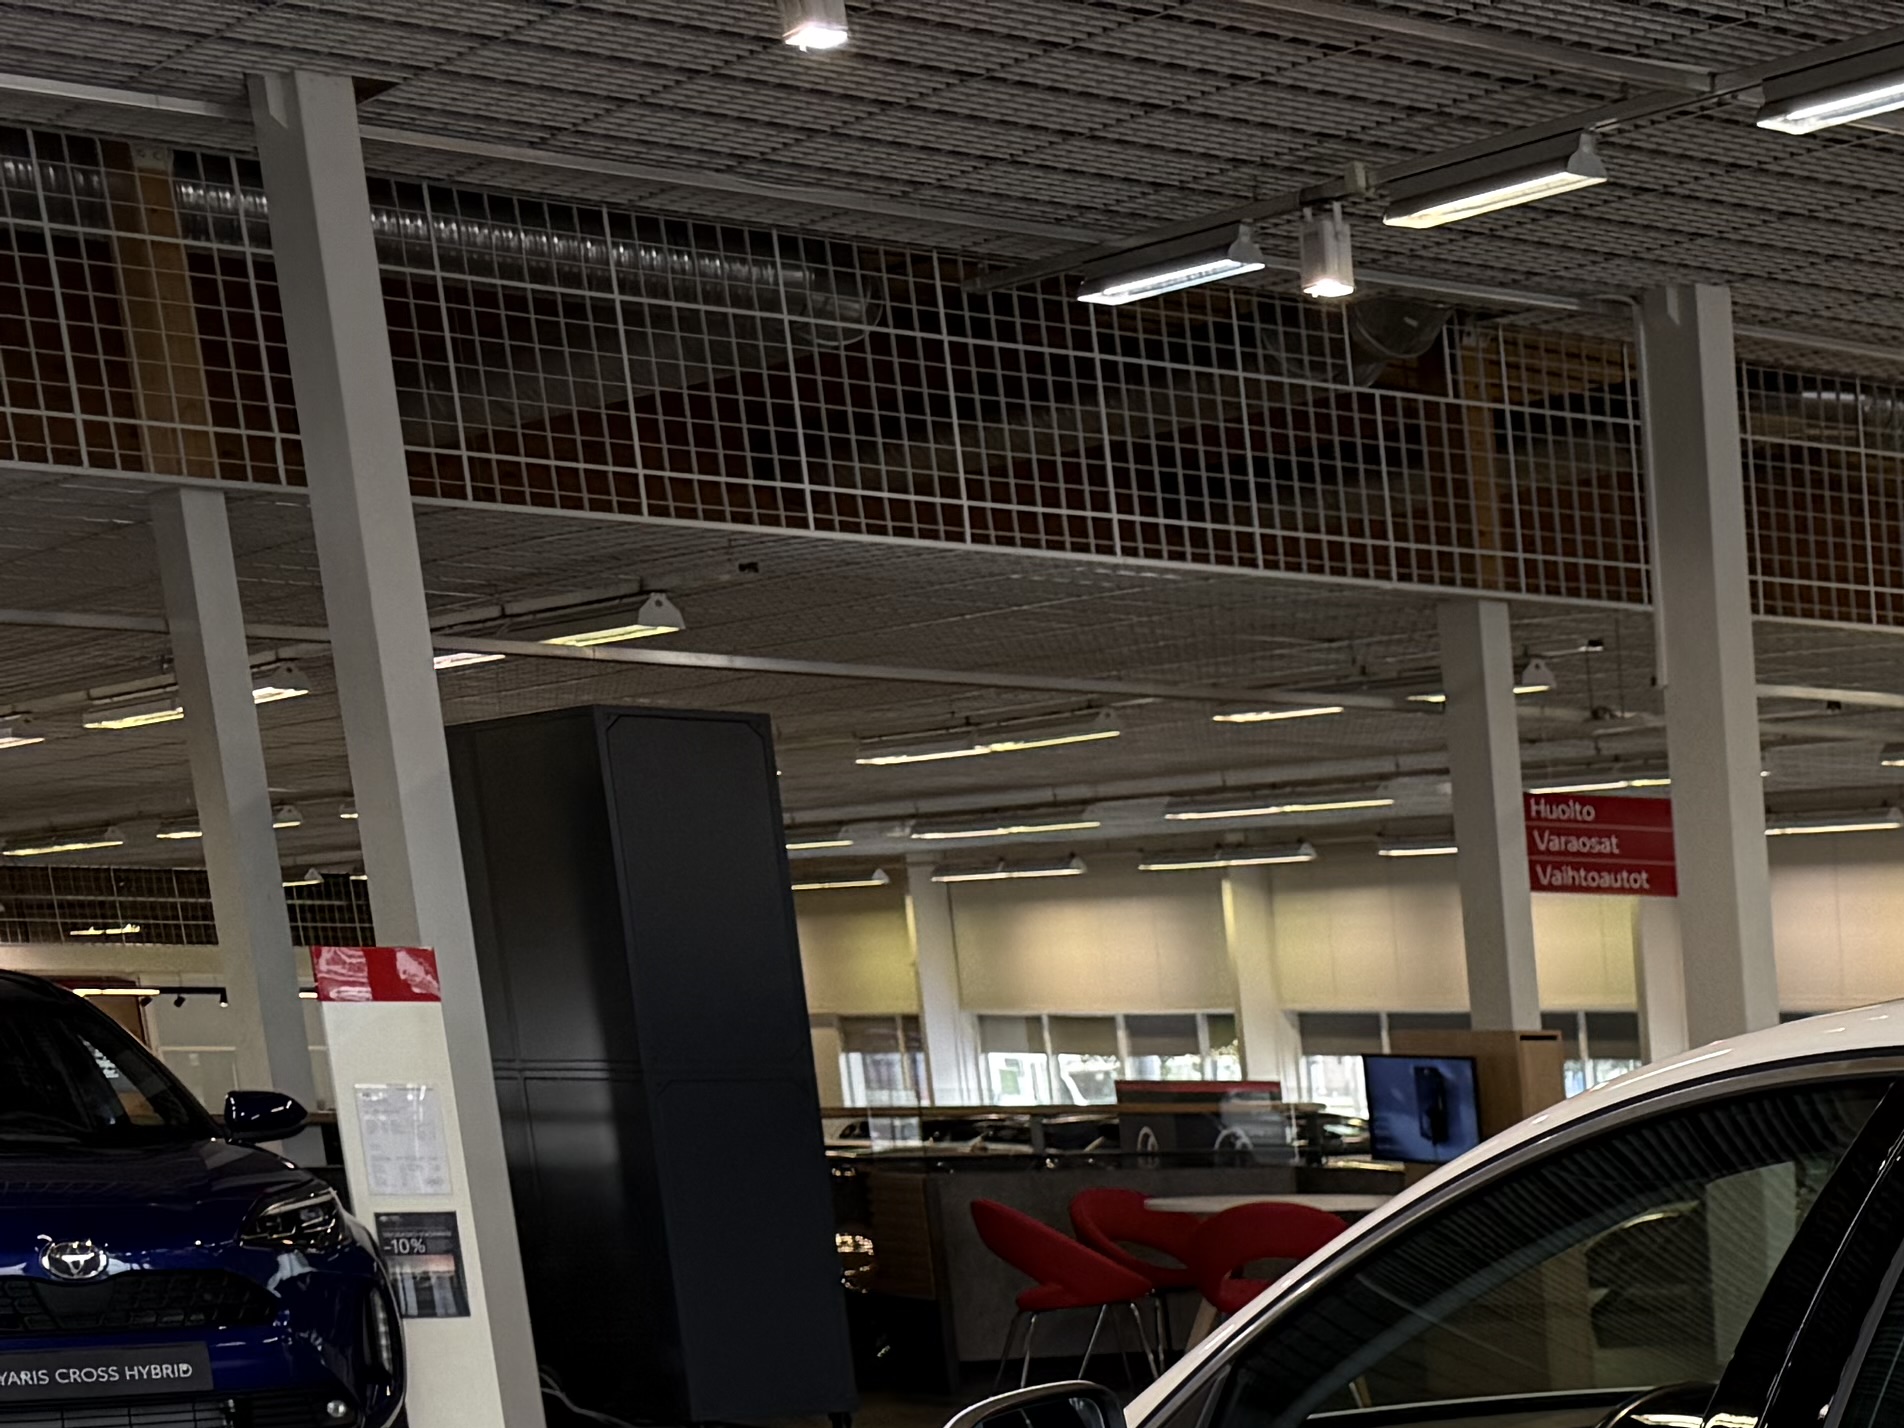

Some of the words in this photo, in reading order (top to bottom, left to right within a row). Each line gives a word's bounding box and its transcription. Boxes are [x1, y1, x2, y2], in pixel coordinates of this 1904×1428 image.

[1530, 798, 1595, 821] Huolto
[1533, 829, 1619, 854] Varaosat
[1536, 864, 1649, 889] Vaihtoautot
[384, 1238, 426, 1254] -10%
[0, 1369, 49, 1386] YARIS
[55, 1366, 119, 1384] CROSS
[125, 1363, 193, 1380] HYBRID
